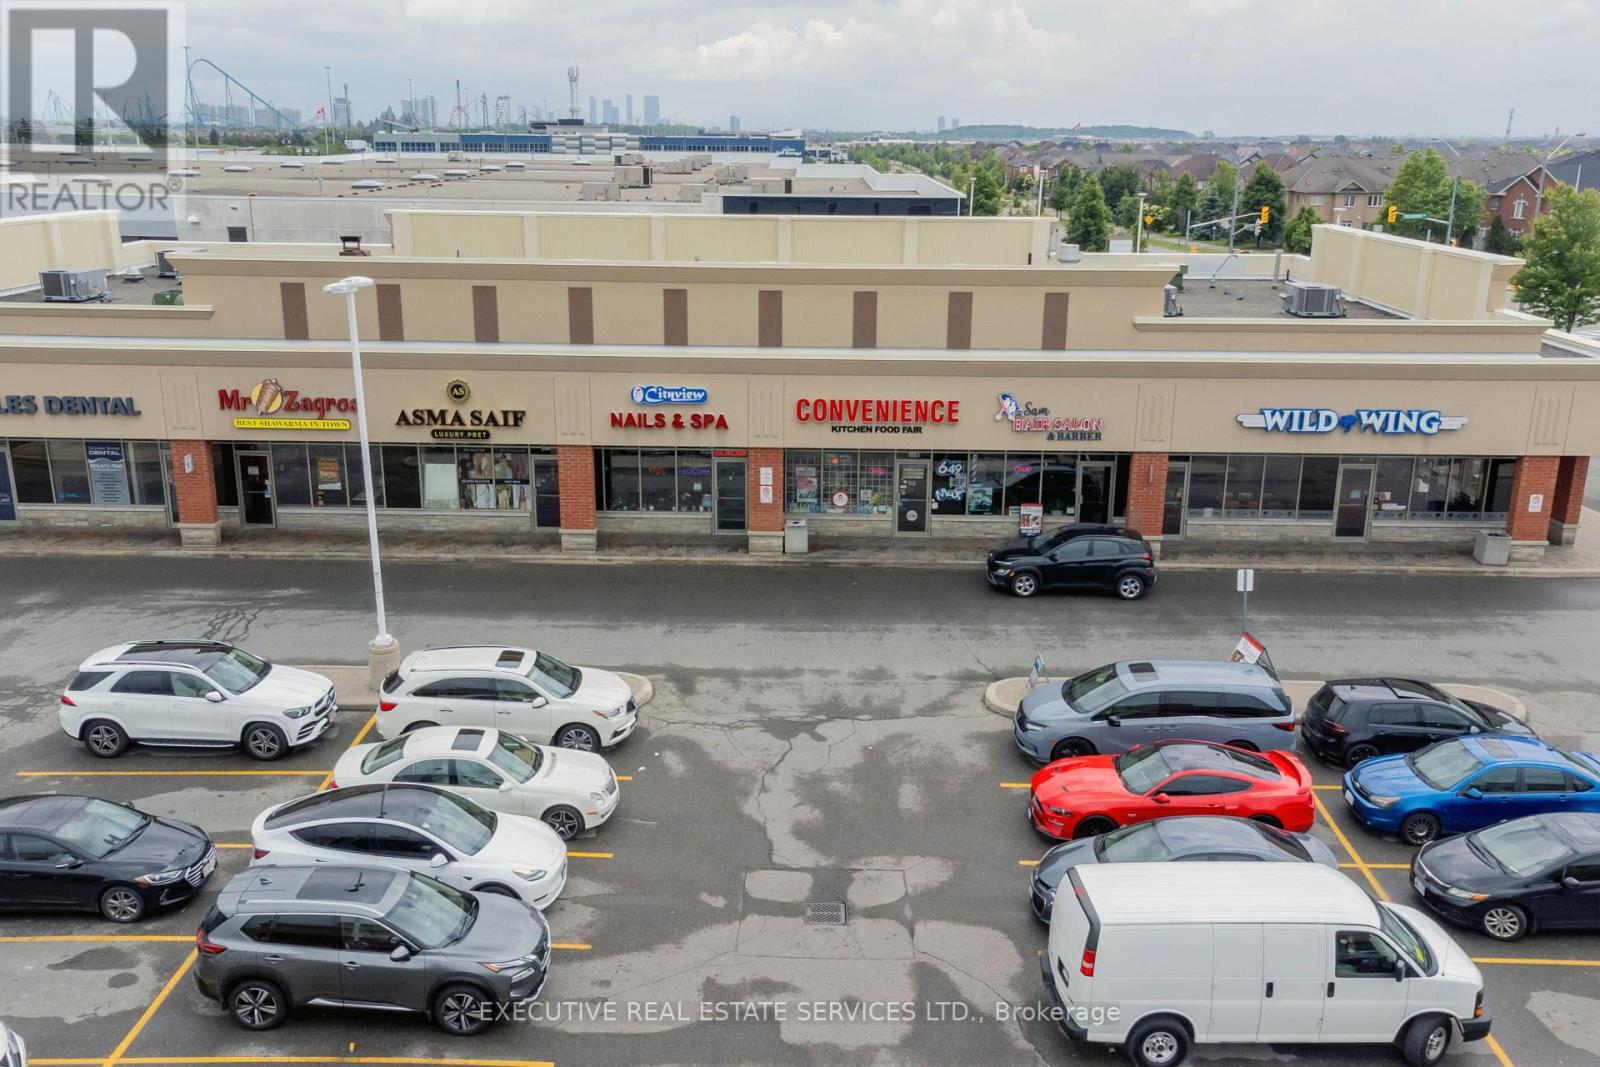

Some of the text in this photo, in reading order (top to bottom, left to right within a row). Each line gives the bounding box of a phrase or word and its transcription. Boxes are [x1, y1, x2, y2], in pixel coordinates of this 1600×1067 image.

[452, 387, 465, 395] AS
[645, 386, 705, 403] Cityview
[43, 396, 142, 416] DENTAL
[218, 389, 252, 411] Mr
[1024, 401, 1050, 416] Sam
[395, 409, 526, 427] ASMA SAIF
[796, 398, 960, 424] CONVENIENCE
[259, 420, 308, 428] SHAWARMA
[610, 412, 729, 430] NAILS & SPA
[831, 425, 873, 433] KITCHEN
[902, 426, 923, 434] FAIR
[1013, 417, 1104, 431] HAIR SALON
[1261, 409, 1441, 434] WILD WING
[1046, 432, 1102, 441] & BARBER
